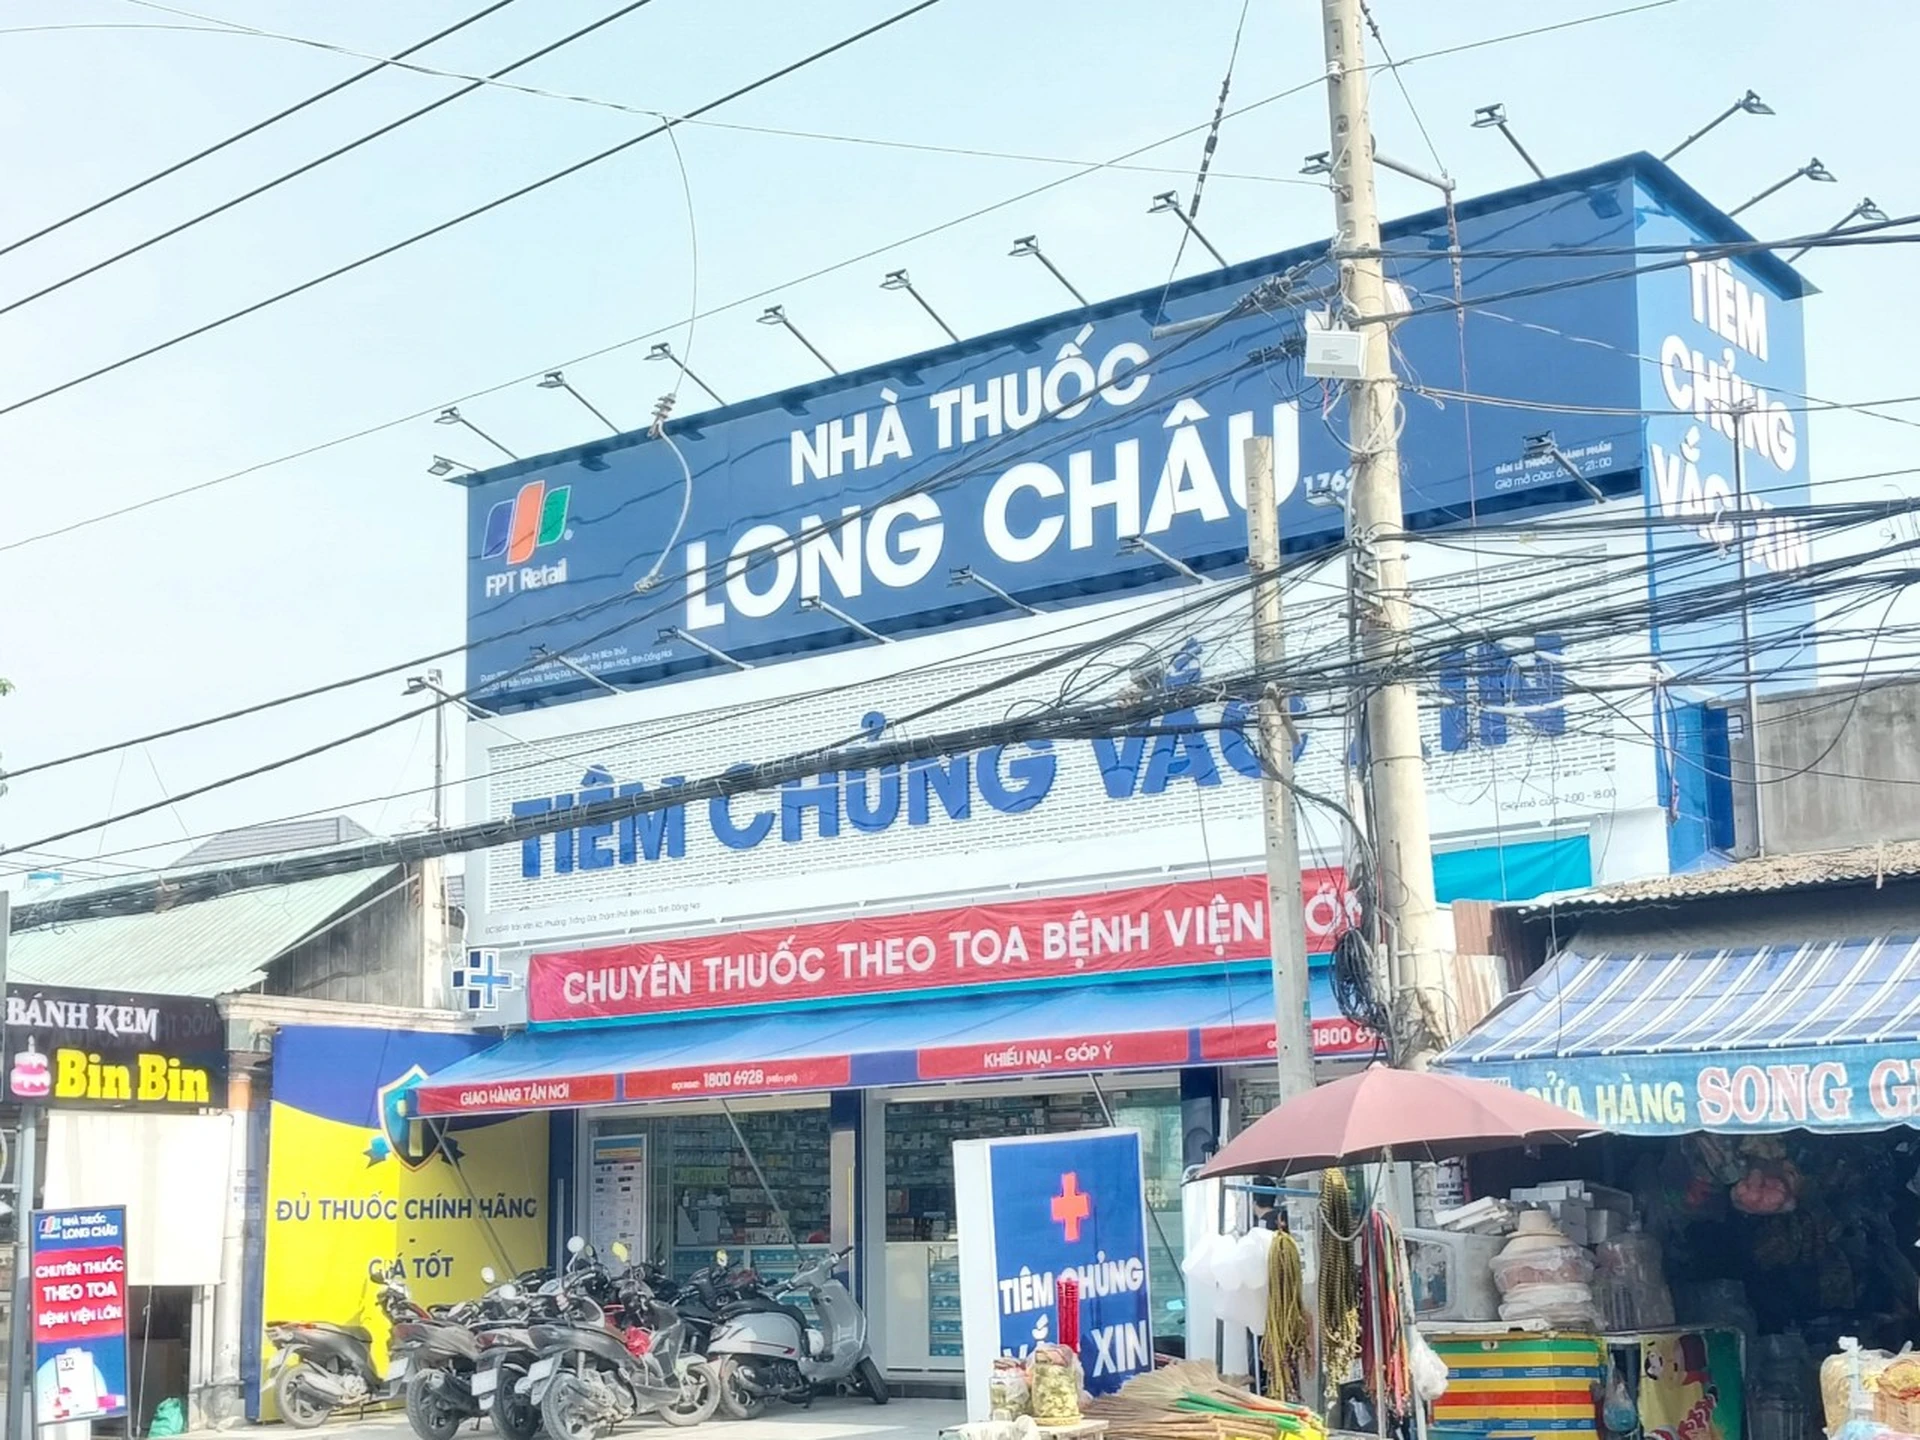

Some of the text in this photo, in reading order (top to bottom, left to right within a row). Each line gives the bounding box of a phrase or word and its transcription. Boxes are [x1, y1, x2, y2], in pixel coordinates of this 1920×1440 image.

[1686, 251, 1768, 362] TIÊM
[790, 323, 1151, 485] NHÀ THUỐC
[1660, 335, 1796, 472] CHỦNG
[686, 398, 1301, 630] LONG CHÂU
[485, 557, 567, 598] FPT Retail
[511, 765, 686, 878] TIÊM
[708, 712, 1057, 850] CHỦNG
[563, 953, 692, 1006] CHUYÊN
[703, 926, 826, 992] THUỐC
[836, 930, 937, 979] THEO
[949, 925, 1030, 969] TOA
[1042, 909, 1150, 969] BỆNH
[1163, 893, 1264, 956] VIỆN
[5, 993, 89, 1029] BÁNH
[95, 1004, 159, 1041] KEM
[1312, 1026, 1352, 1047] 1800
[55, 1048, 209, 1103] Bin Bin
[983, 1045, 1024, 1069] KHIẾU
[1025, 1048, 1053, 1069] NẠI
[1064, 1042, 1100, 1063] GÓP
[1102, 1040, 1113, 1060] Ý
[460, 1082, 570, 1105] GIAO HÀNG TẬN NƠI
[703, 1071, 731, 1088] 1800
[733, 1069, 764, 1086] 6928
[1596, 1072, 1685, 1125] HÀNG
[1697, 1061, 1853, 1125] SONG
[276, 1190, 537, 1221] ĐỦ THUỐC CHÍNH HÃNG
[62, 1226, 90, 1239] LONG
[35, 1256, 123, 1279] CHUYÊN THUỐC
[412, 1249, 454, 1278] TỐT
[43, 1280, 117, 1302] THEO TOA
[998, 1264, 1054, 1315] TIÊM
[39, 1310, 69, 1329] BỆNH
[1090, 1319, 1149, 1378] XIN
